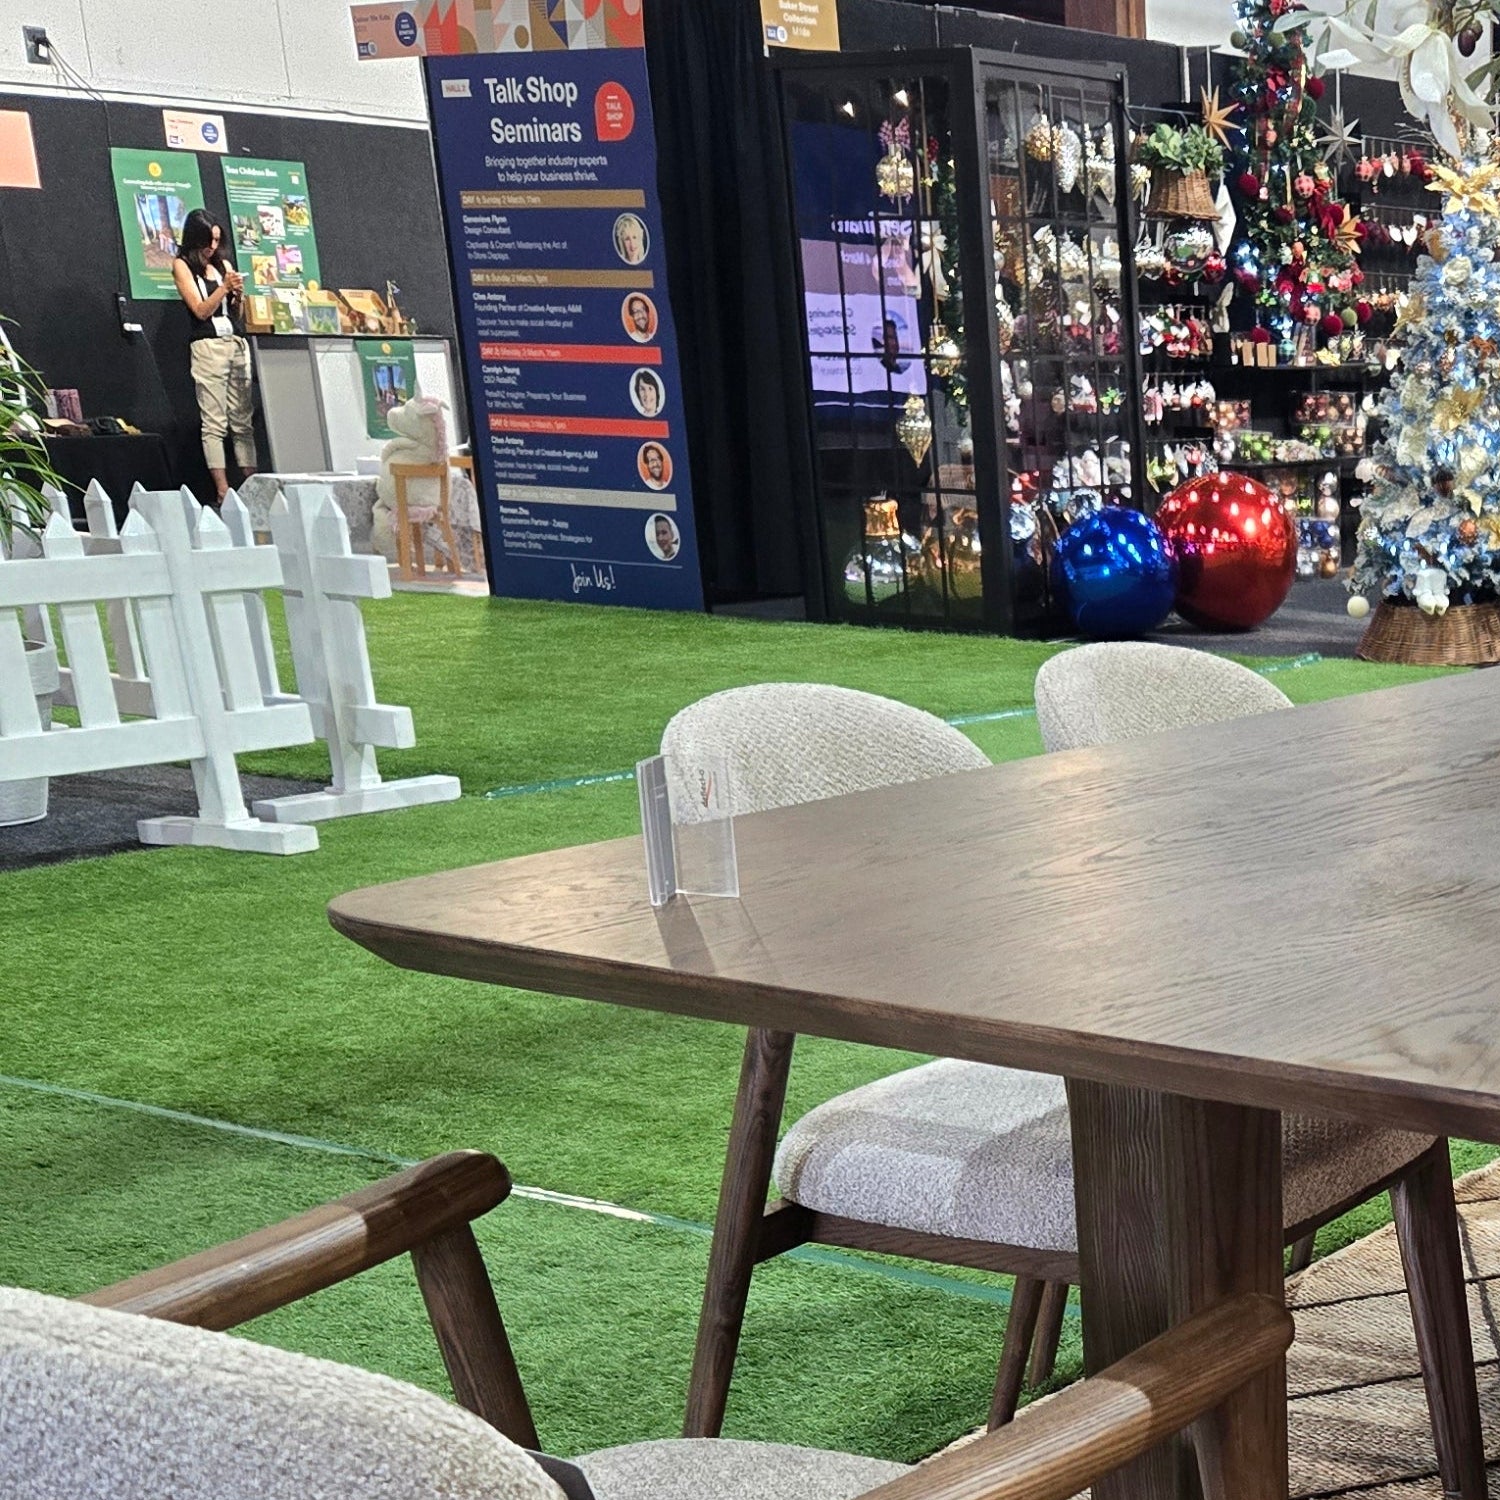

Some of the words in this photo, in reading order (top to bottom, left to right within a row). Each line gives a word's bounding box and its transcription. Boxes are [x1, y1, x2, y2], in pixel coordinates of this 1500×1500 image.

[484, 77, 525, 104] Talk
[526, 76, 578, 108] Shop
[490, 117, 582, 144] Seminars
[485, 155, 515, 169] Bringing
[515, 155, 546, 169] together
[547, 155, 578, 168] industry
[578, 156, 608, 167] experts
[506, 171, 522, 182] help
[523, 173, 539, 184] your
[539, 170, 573, 182] business
[571, 563, 593, 593] Join
[593, 564, 617, 590] Us!
